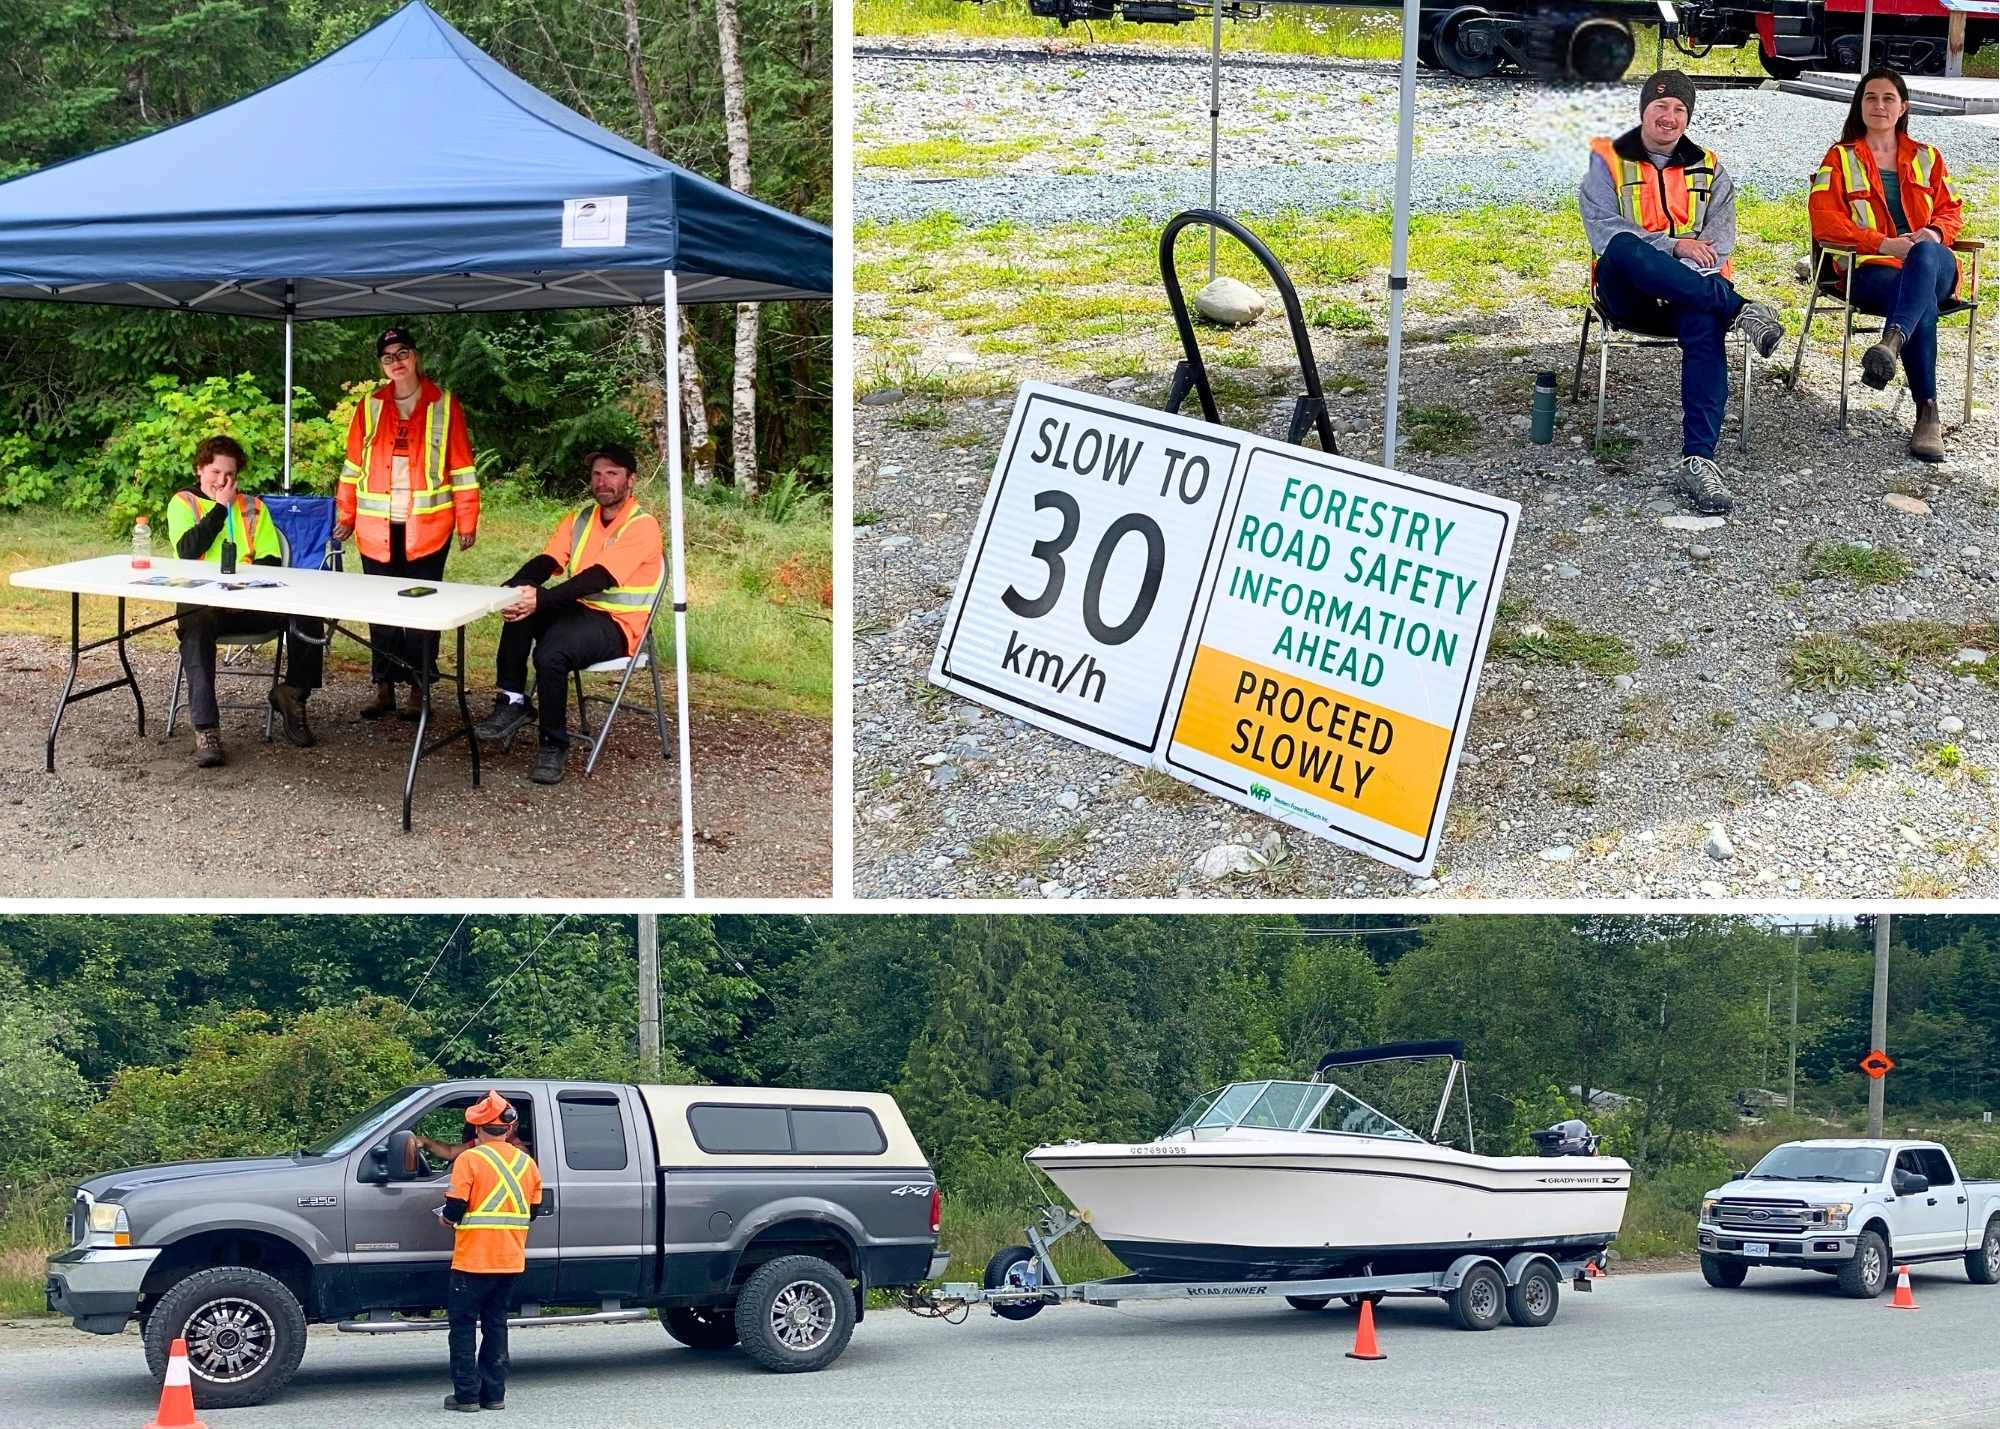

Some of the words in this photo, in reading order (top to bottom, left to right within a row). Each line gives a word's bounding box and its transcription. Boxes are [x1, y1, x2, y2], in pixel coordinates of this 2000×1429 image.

[1031, 417, 1145, 486] SLOW
[1161, 447, 1210, 505] TO
[1280, 477, 1456, 557] FORESTRY
[1001, 489, 1166, 646] 30
[1237, 515, 1331, 572] ROAD
[1344, 546, 1478, 616] SAFETY
[1229, 566, 1459, 667] INFORMATION
[1272, 625, 1384, 688] AHEAD
[1002, 631, 1107, 704] km/h
[1234, 670, 1395, 755] PROCEED
[1230, 718, 1376, 800] SLOWLY
[1250, 783, 1272, 802] WFP
[1304, 808, 1322, 820] Products
[1186, 1287, 1221, 1296] ROAD
[1220, 1286, 1268, 1295] RUNNER
